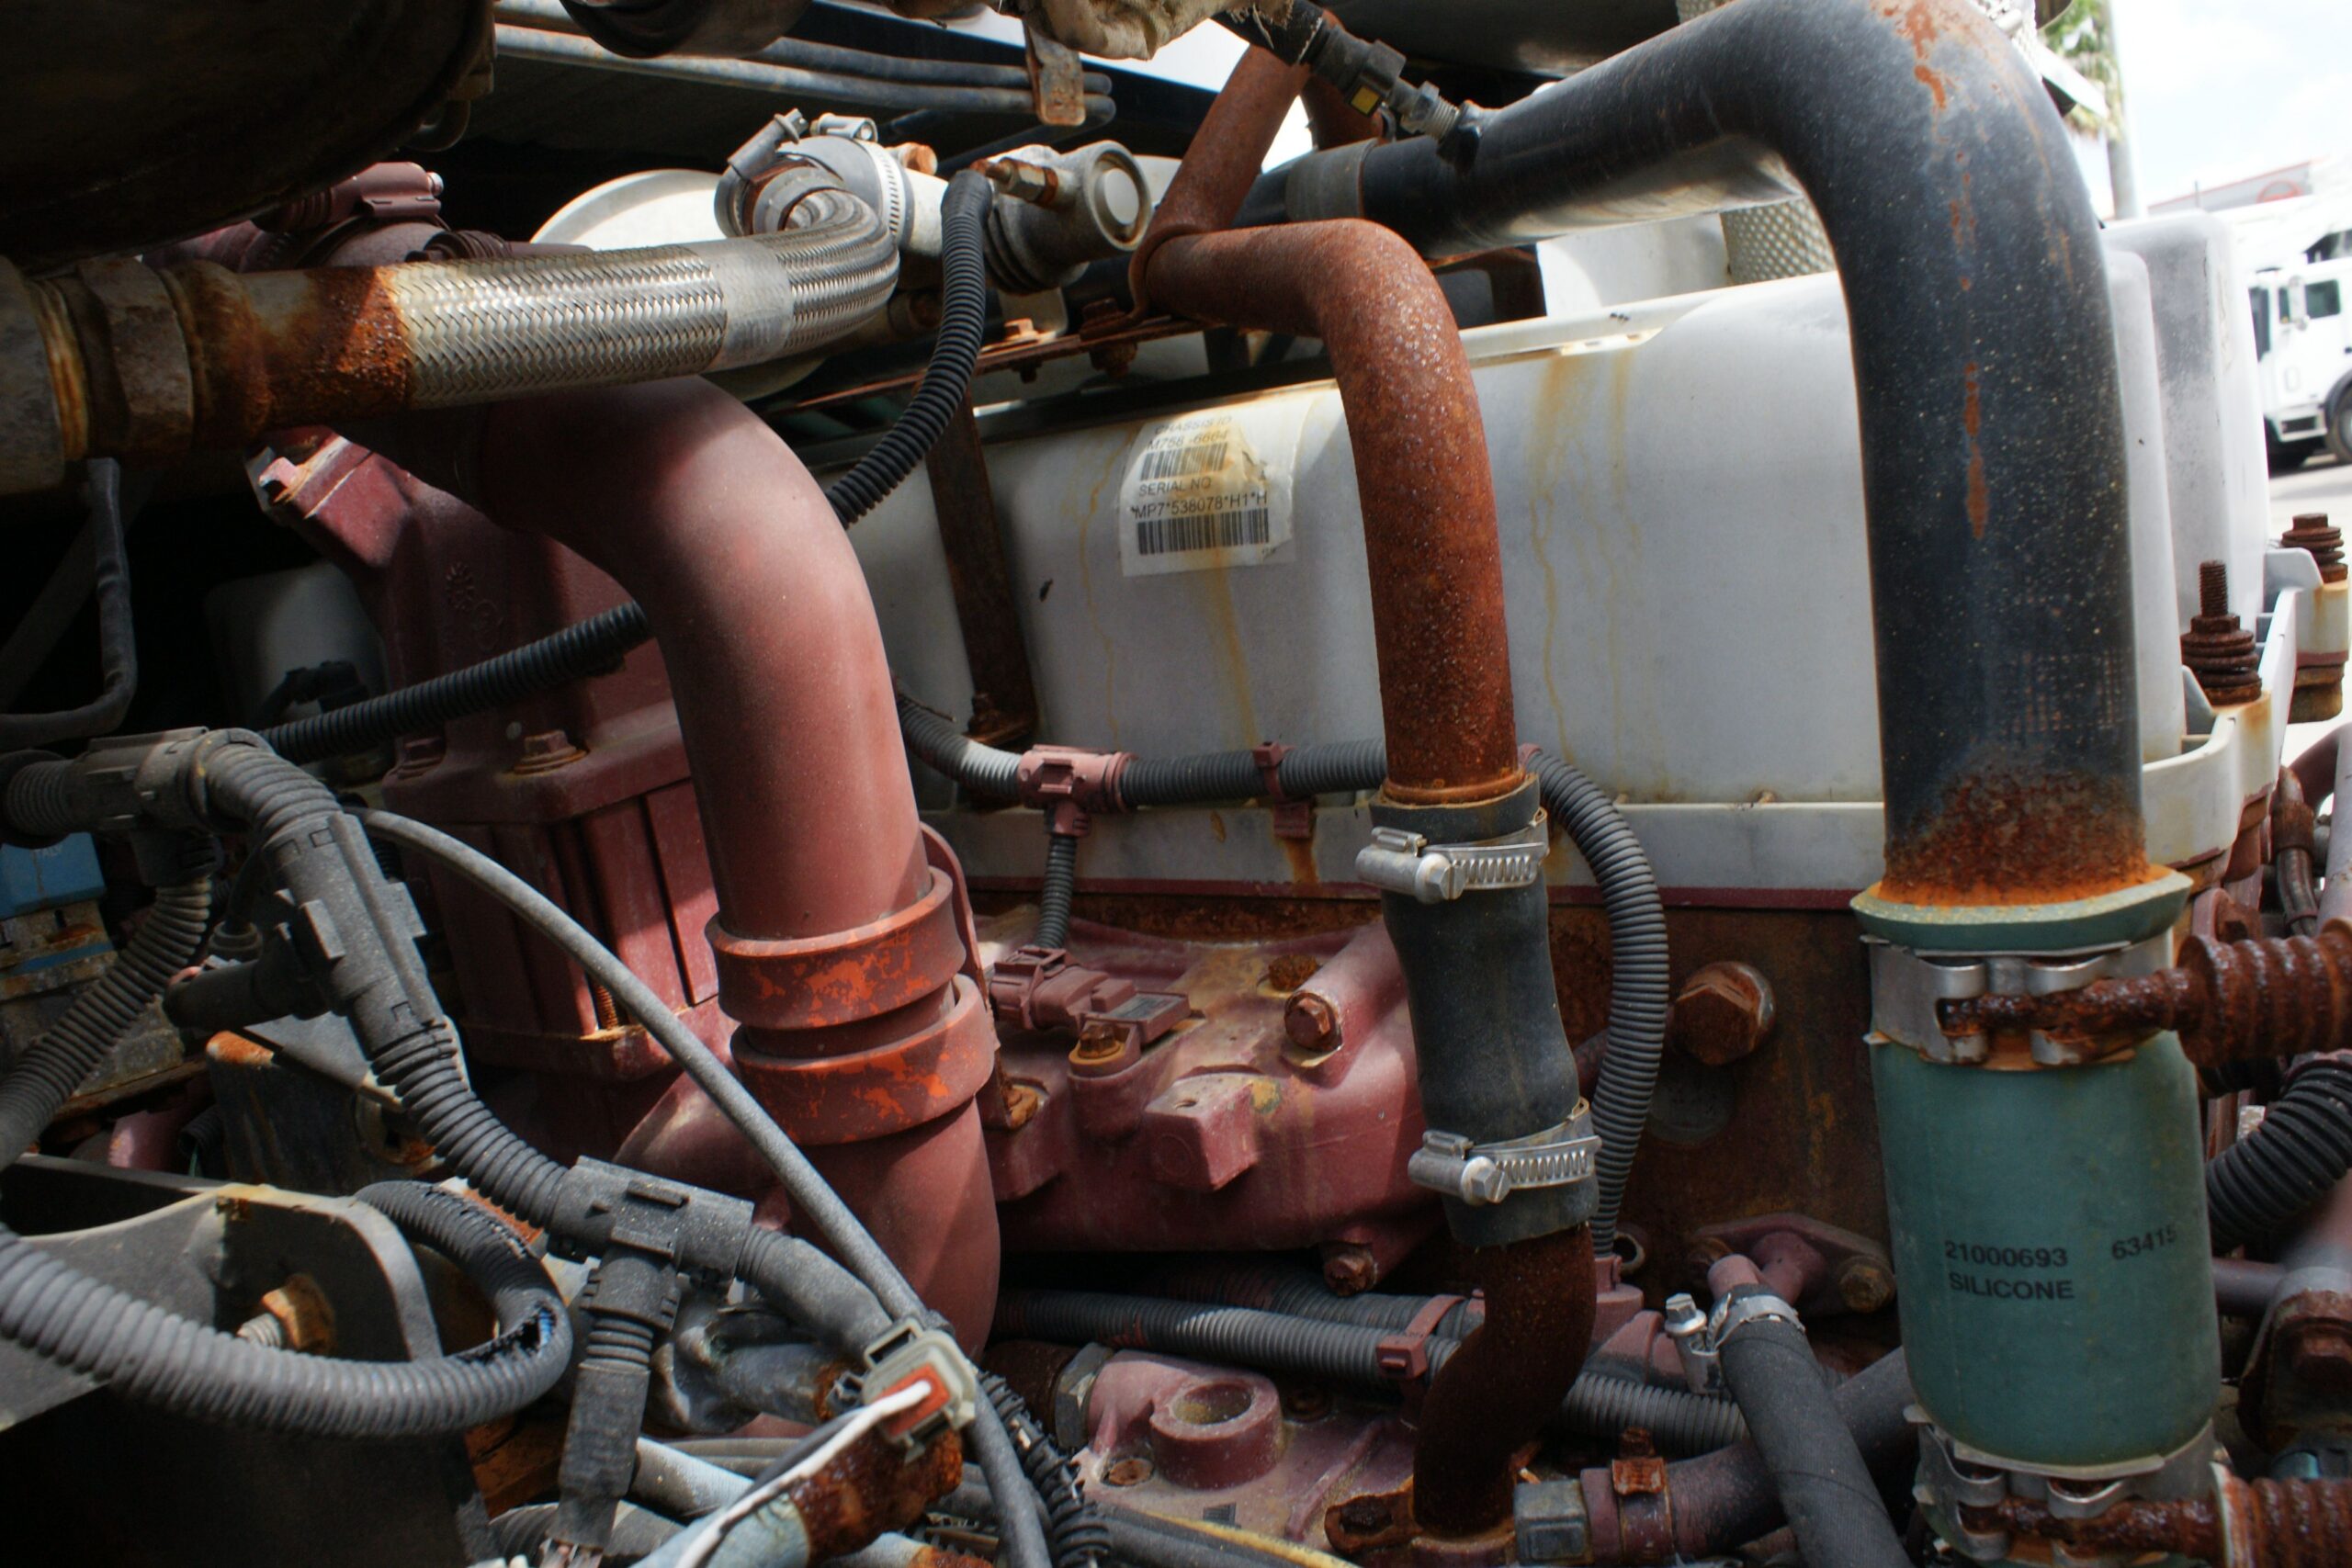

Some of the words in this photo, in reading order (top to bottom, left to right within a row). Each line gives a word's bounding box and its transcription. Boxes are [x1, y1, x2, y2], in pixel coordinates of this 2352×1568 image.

[1155, 418, 1213, 434] CHASSIS
[1139, 480, 1186, 497] SERIAL
[1190, 476, 1213, 491] NO
[1944, 1240, 2068, 1268] 21000693
[2110, 1224, 2178, 1260] 63415
[1949, 1271, 2075, 1301] SILICONE
